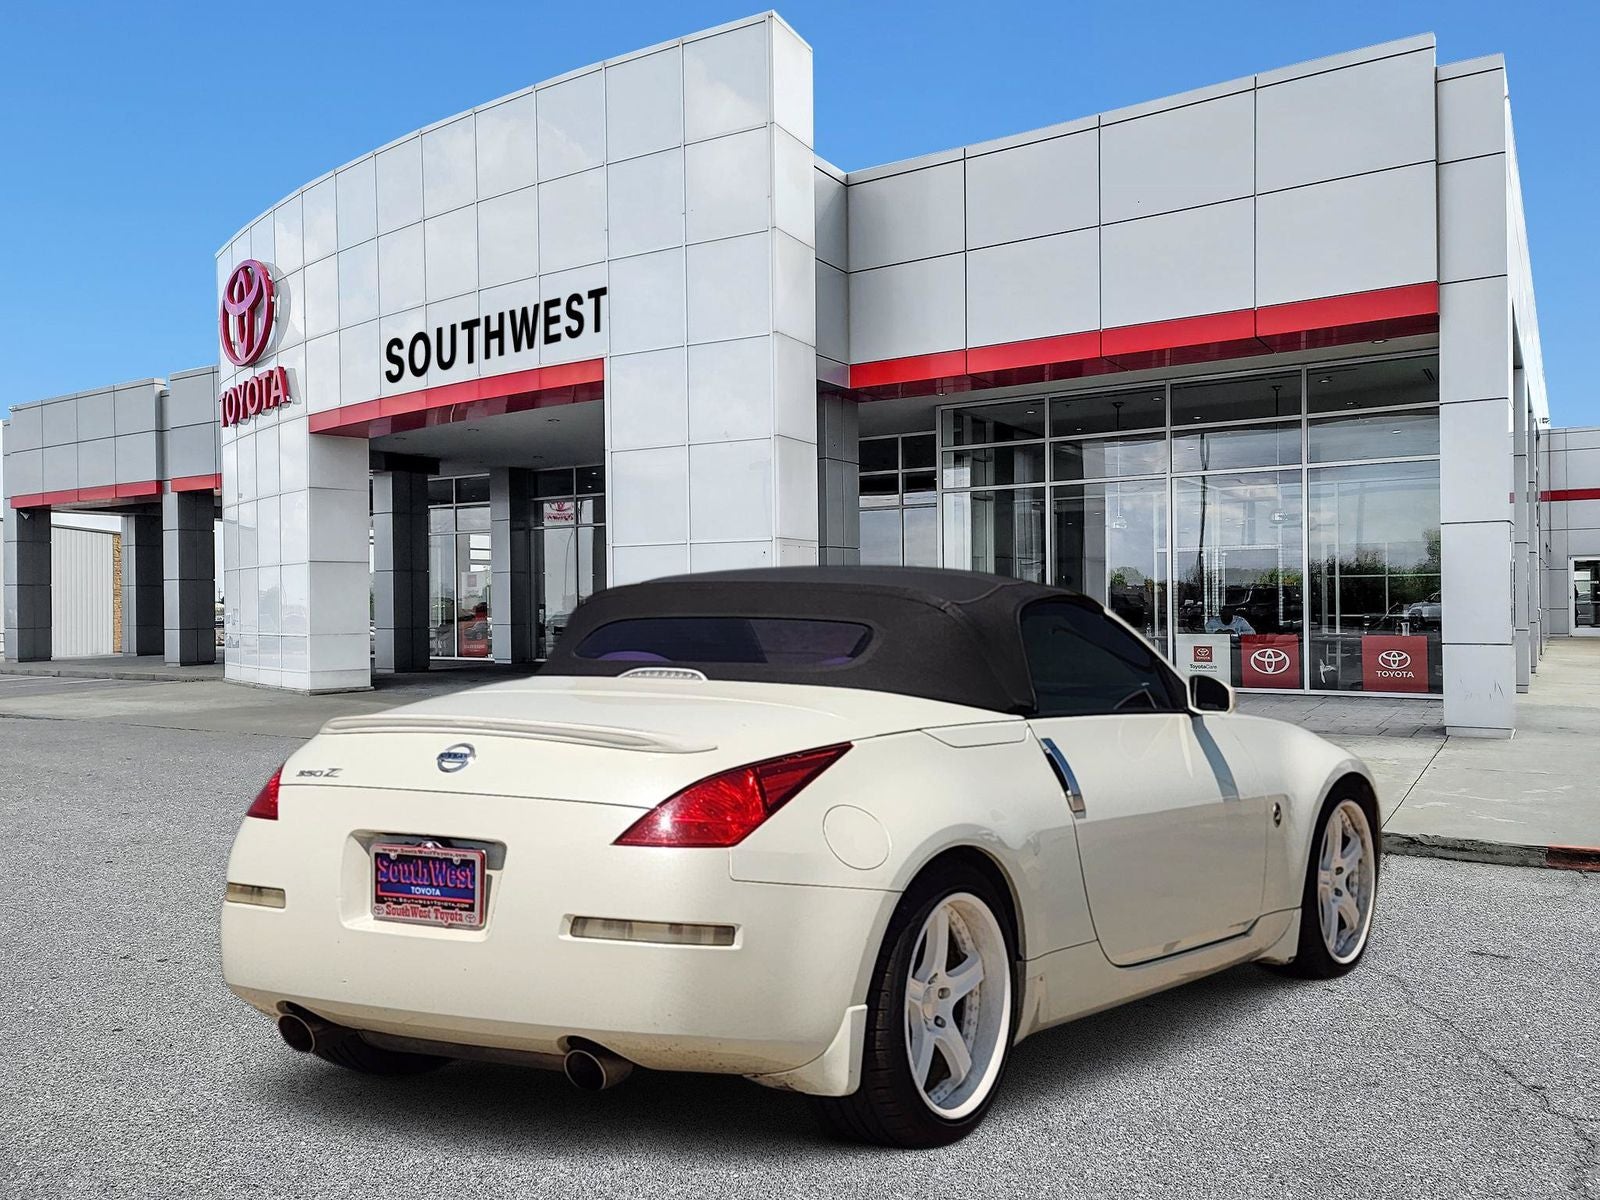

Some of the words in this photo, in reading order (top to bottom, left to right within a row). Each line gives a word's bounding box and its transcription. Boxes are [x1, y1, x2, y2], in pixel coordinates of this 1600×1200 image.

[385, 286, 608, 384] SOUTHWEST
[218, 366, 291, 428] TOYOTA
[410, 886, 441, 896] TOYOTA
[385, 904, 431, 919] SouthWest
[434, 908, 463, 924] Toyota
